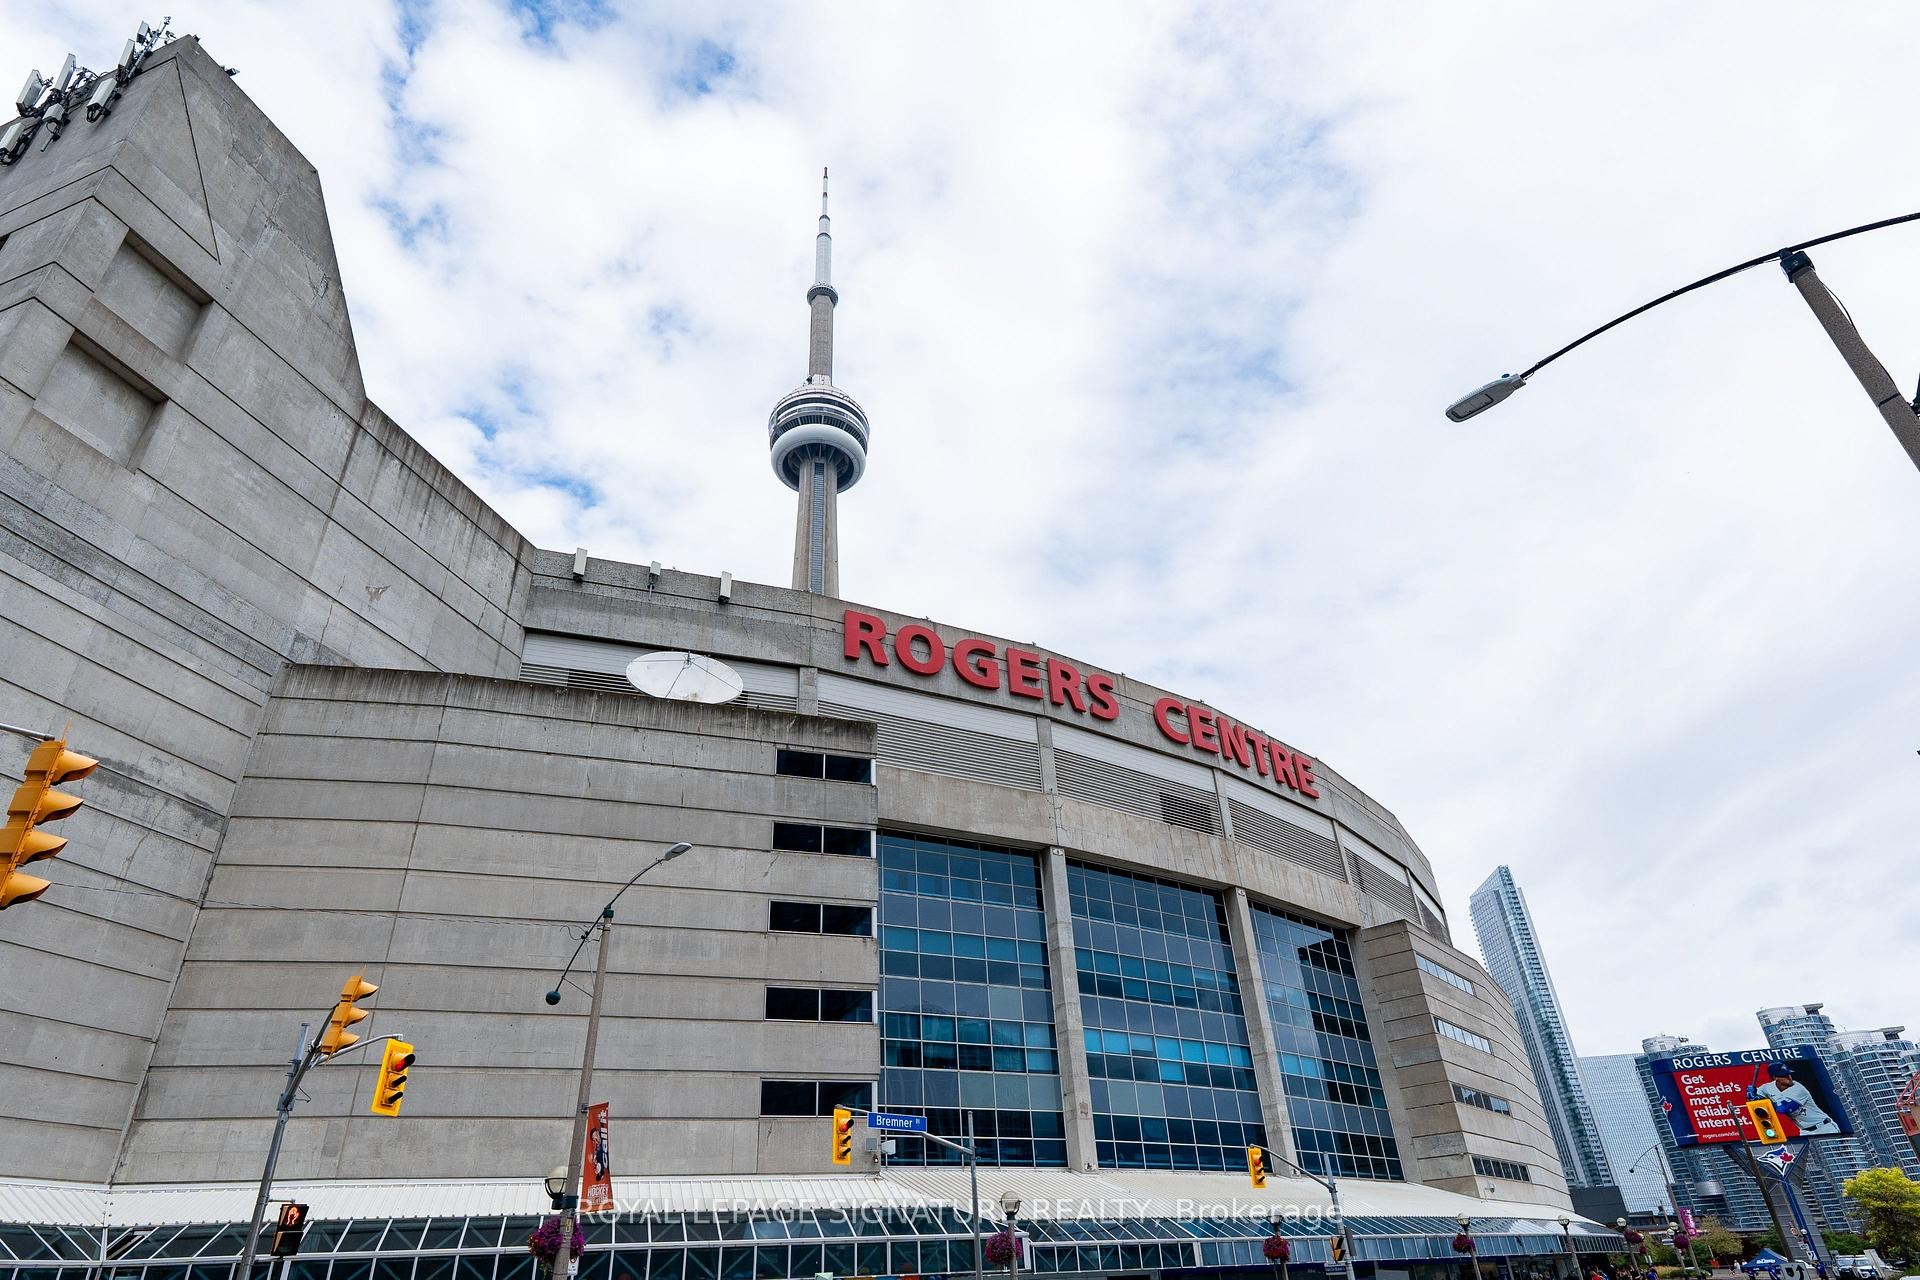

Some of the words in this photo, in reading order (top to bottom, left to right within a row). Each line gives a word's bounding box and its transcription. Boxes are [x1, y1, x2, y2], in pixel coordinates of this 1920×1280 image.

[844, 609, 1120, 721] ROGERS
[1153, 697, 1320, 800] CENTRE
[1673, 1054, 1732, 1070] ROGERS
[1740, 1047, 1803, 1063] CENTRE
[1681, 1074, 1706, 1085] Get
[1685, 1082, 1742, 1096] Canada's
[1689, 1094, 1722, 1106] most
[876, 1115, 913, 1128] Bremner
